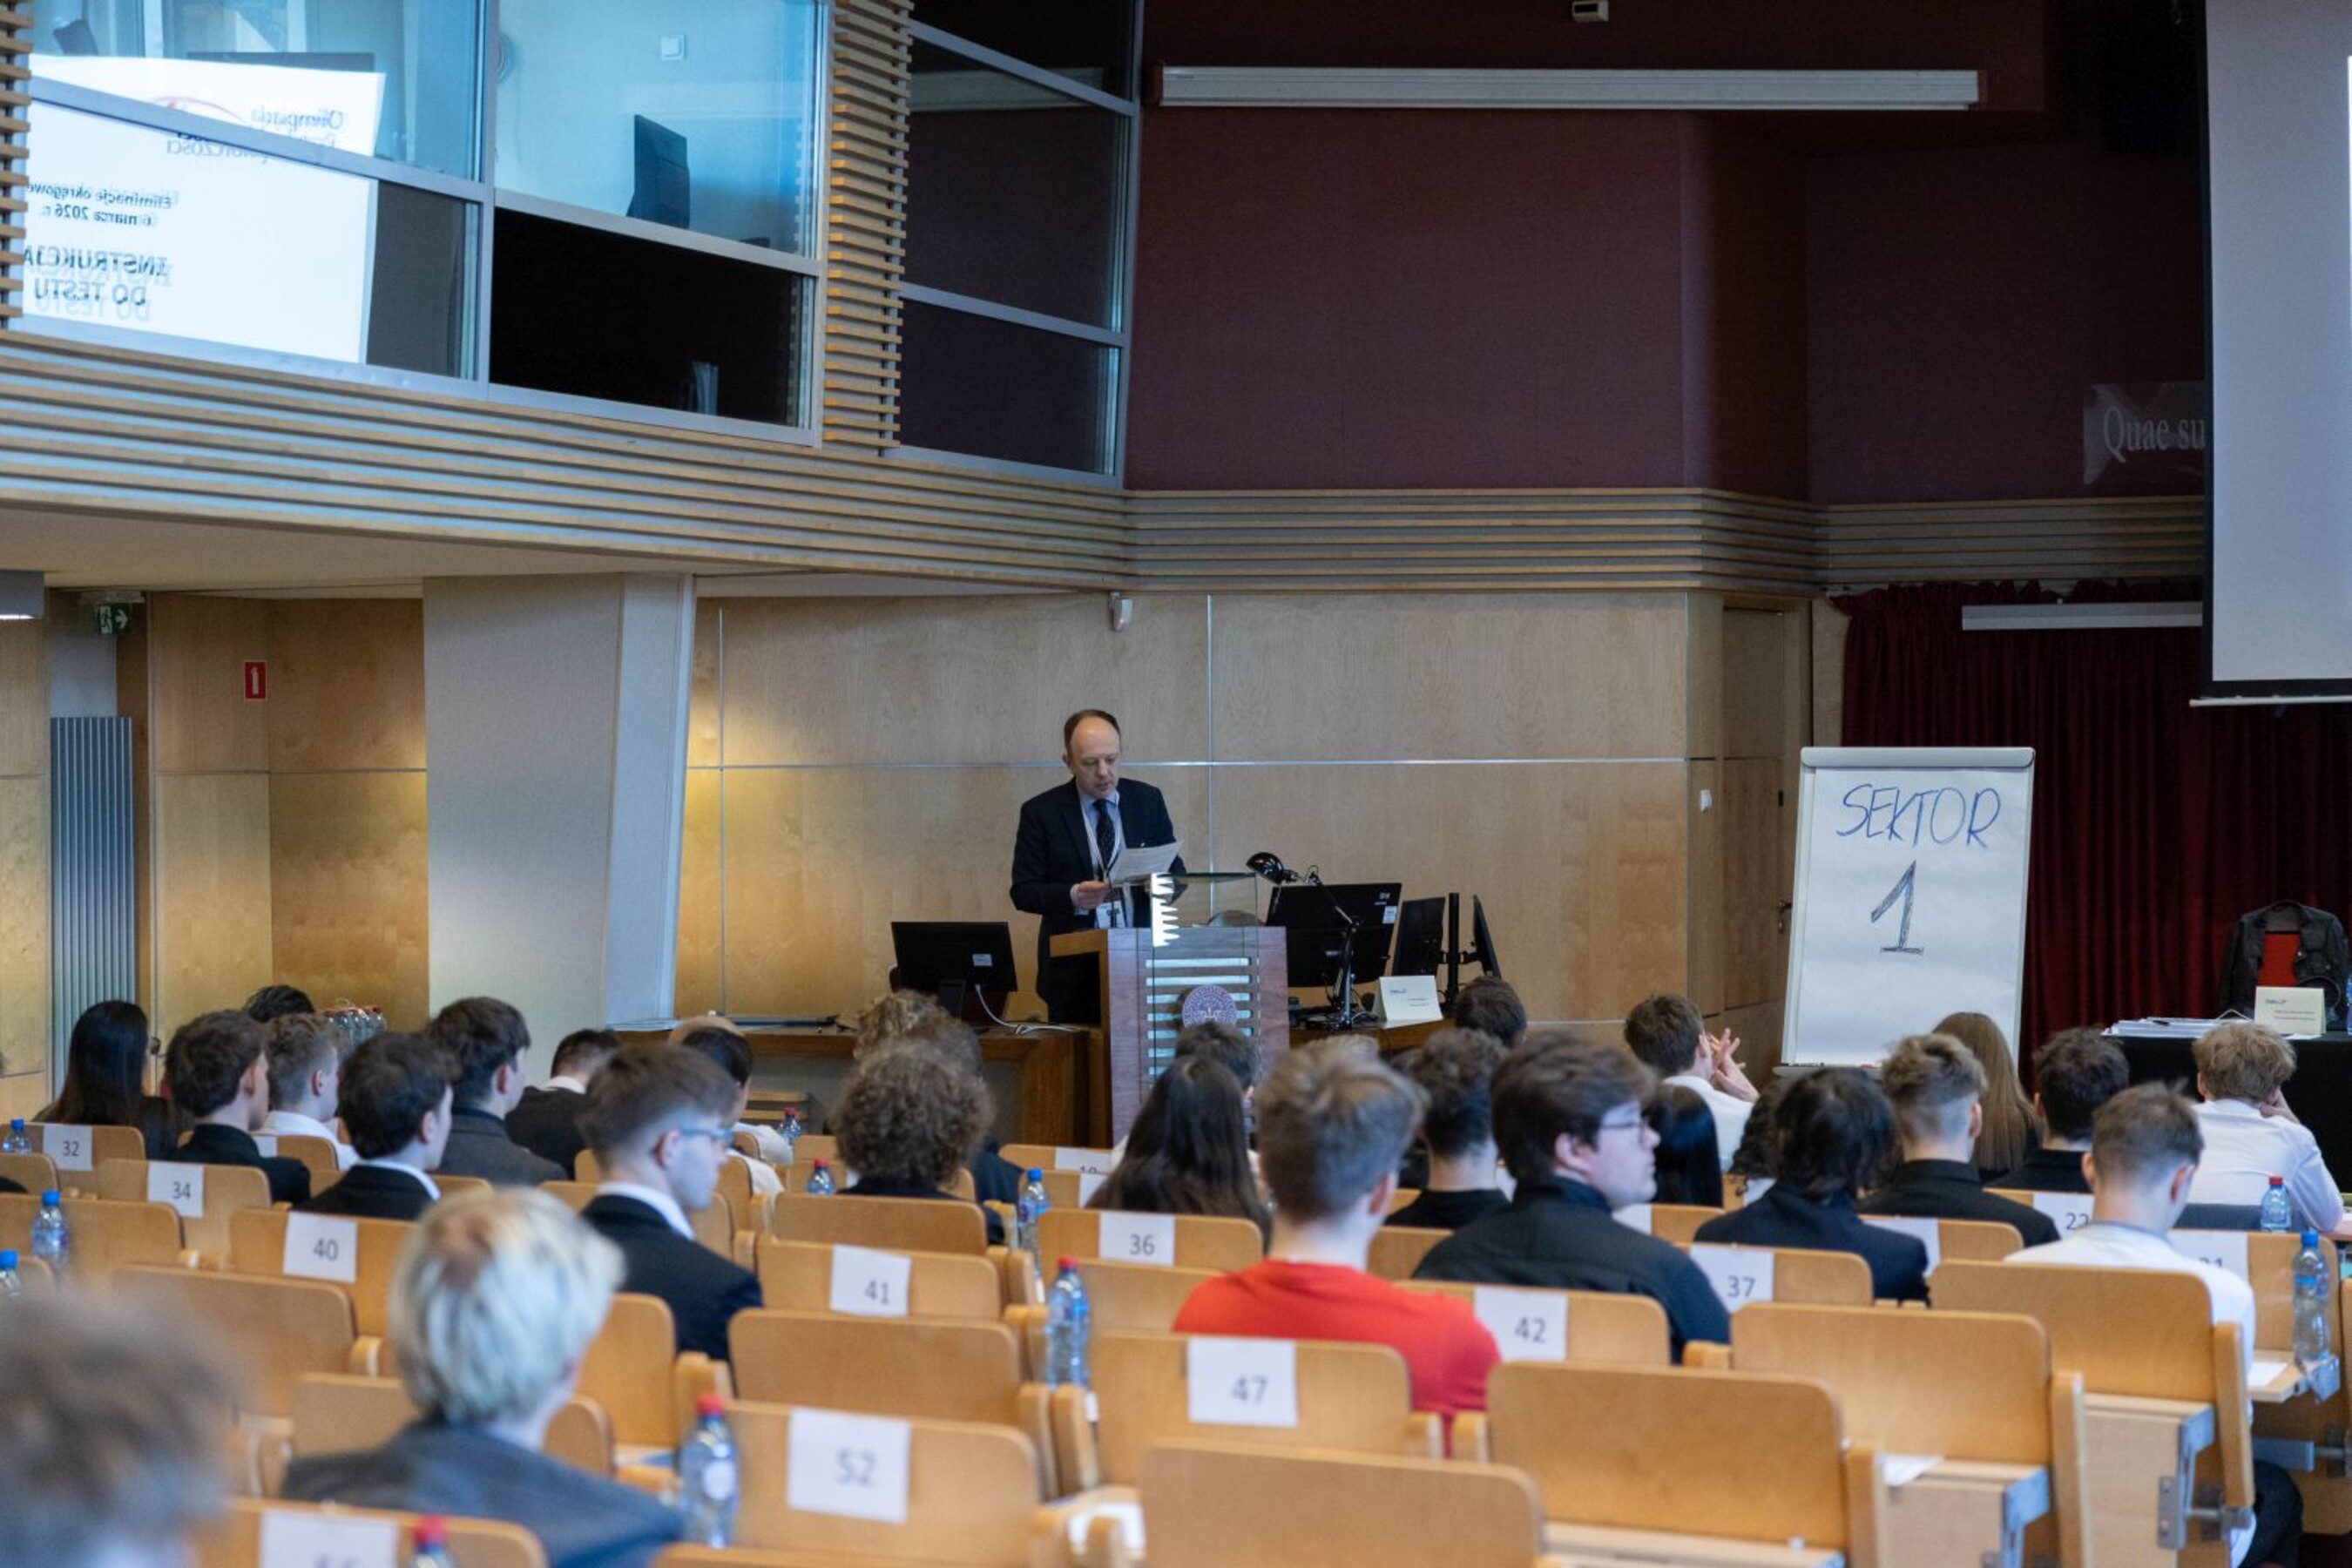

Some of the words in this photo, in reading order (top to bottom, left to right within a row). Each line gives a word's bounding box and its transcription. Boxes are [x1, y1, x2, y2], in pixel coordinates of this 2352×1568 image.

[2103, 405, 2170, 463] Quae
[1836, 783, 2002, 849] SEKTOR
[1870, 859, 1924, 955] 1
[62, 1139, 80, 1157] 32
[172, 1181, 192, 1200] 34
[313, 1238, 340, 1262] 40
[1129, 1233, 1156, 1256] 36
[864, 1278, 889, 1306] 41
[1727, 1274, 1756, 1299] 37
[1514, 1315, 1546, 1344] 42
[1231, 1374, 1268, 1405] 47
[835, 1446, 877, 1489] 52
